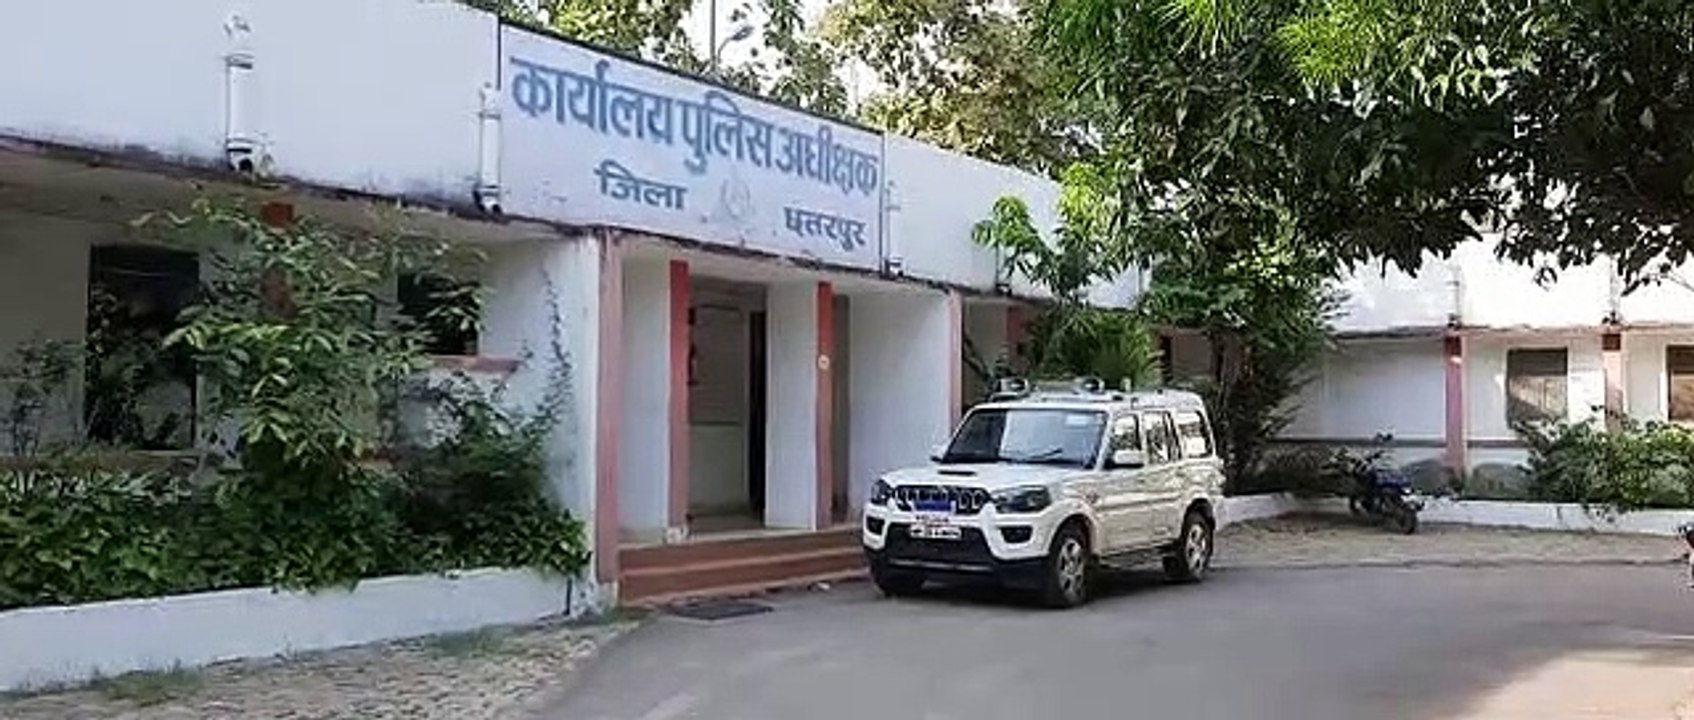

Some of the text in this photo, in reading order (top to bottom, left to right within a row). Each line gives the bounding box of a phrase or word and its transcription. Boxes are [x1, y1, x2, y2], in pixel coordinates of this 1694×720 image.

[510, 57, 879, 196] कार्यालय पुलिस अधीक्षक
[593, 158, 688, 210] जिला
